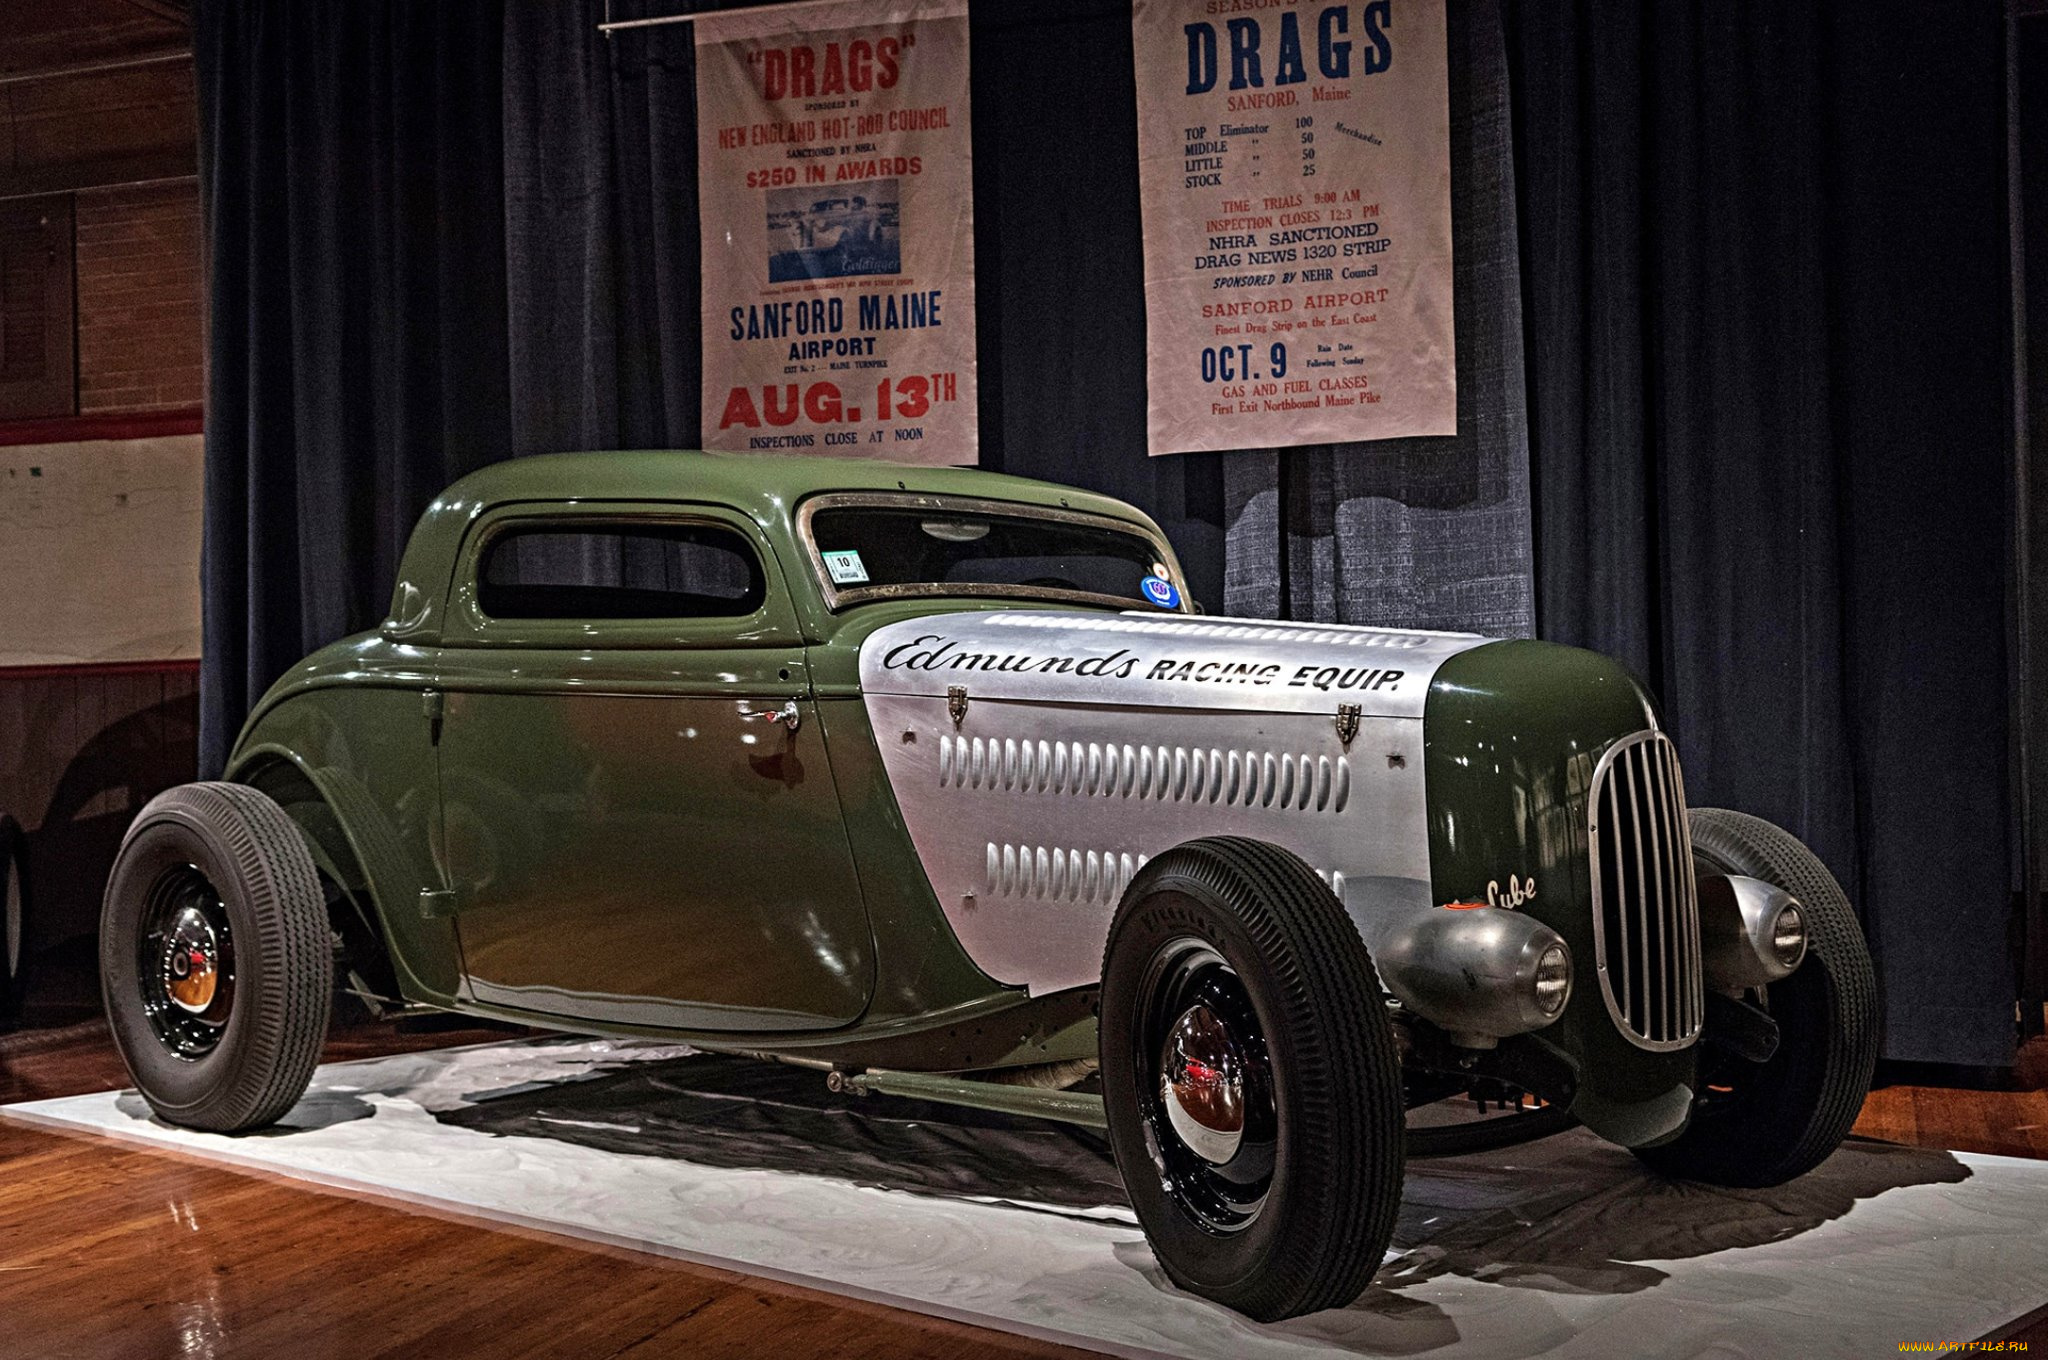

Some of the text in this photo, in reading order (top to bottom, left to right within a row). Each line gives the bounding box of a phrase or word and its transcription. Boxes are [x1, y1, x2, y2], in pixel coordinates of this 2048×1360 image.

[1184, 0, 1392, 95] DRAGS
[805, 100, 859, 111] SPONSORED BY
[1227, 86, 1351, 112] SANFORD, Maine
[718, 125, 747, 149] NEW
[753, 120, 815, 146] ENGLAND
[889, 106, 950, 132] COUNCIL
[1185, 116, 1313, 140] TOP Eliminator 100
[1335, 122, 1382, 147] Merchandise
[787, 143, 876, 159] SANCTIONED BY NHRA
[1185, 133, 1314, 157] MIDDLE 50
[746, 157, 922, 188] $250 IN AWARDS
[1185, 149, 1315, 173] LITTLE 50
[1185, 165, 1316, 189] STOCK 25
[1222, 189, 1361, 214] TIME TRIALS 9:00 AM
[1206, 216, 1273, 233] INSPECTION
[1280, 210, 1320, 227] CLOSES
[1363, 203, 1380, 217] PM
[1209, 223, 1379, 251] NHRA SANCTIONED
[1195, 238, 1392, 270] DRAG NEWS 1320 STRIP
[1213, 264, 1378, 289] SPONSORED BY NEHR Council
[1202, 289, 1389, 318] SANFORD AIRPORT
[730, 291, 942, 341] SANFORD MAINE
[1215, 312, 1377, 336] Finest Drag Strip on the East Coast
[789, 337, 876, 361] AIRPORT
[1317, 343, 1353, 353] Rain Date
[784, 365, 797, 374] EXIT
[830, 361, 850, 370] MAINE
[855, 360, 888, 369] TURNPIKE
[1201, 342, 1287, 383] OCT. 9
[1306, 356, 1364, 368] Following Sunday
[1222, 376, 1368, 398] GAS AND FUEL CLASSES
[719, 381, 861, 430] AUG.
[1212, 391, 1381, 415] First Exit Northbound Maine Pike
[750, 428, 923, 450] INSPECTIONS CLOSE AT NOON
[837, 557, 851, 567] 10
[883, 635, 1405, 691] Edmunds RACING EQUIP.
